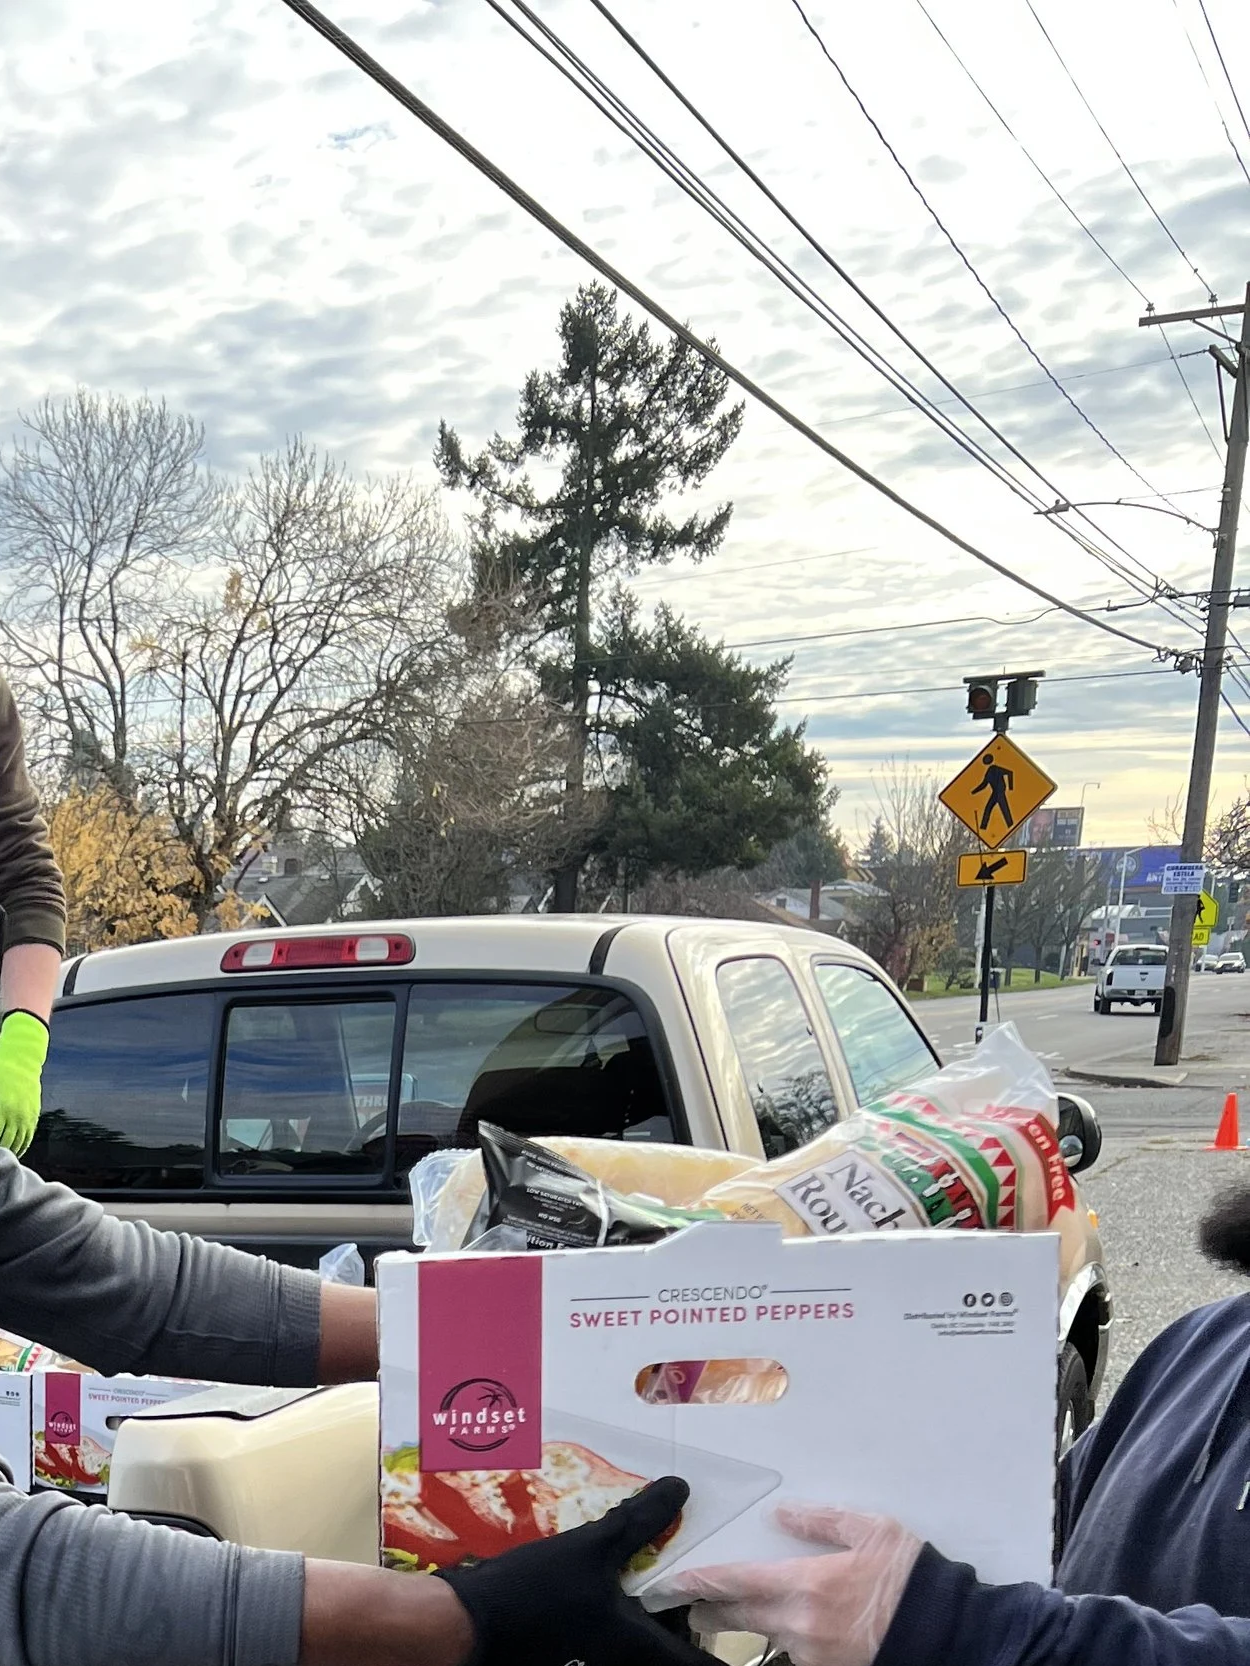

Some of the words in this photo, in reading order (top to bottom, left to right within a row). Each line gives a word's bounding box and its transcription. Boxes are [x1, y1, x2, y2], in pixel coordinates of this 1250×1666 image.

[1047, 1152, 1068, 1201] Free
[570, 1311, 642, 1328] SWEET
[650, 1306, 747, 1326] POINTED
[755, 1303, 855, 1321] PEPPERS
[432, 1407, 527, 1426] windset
